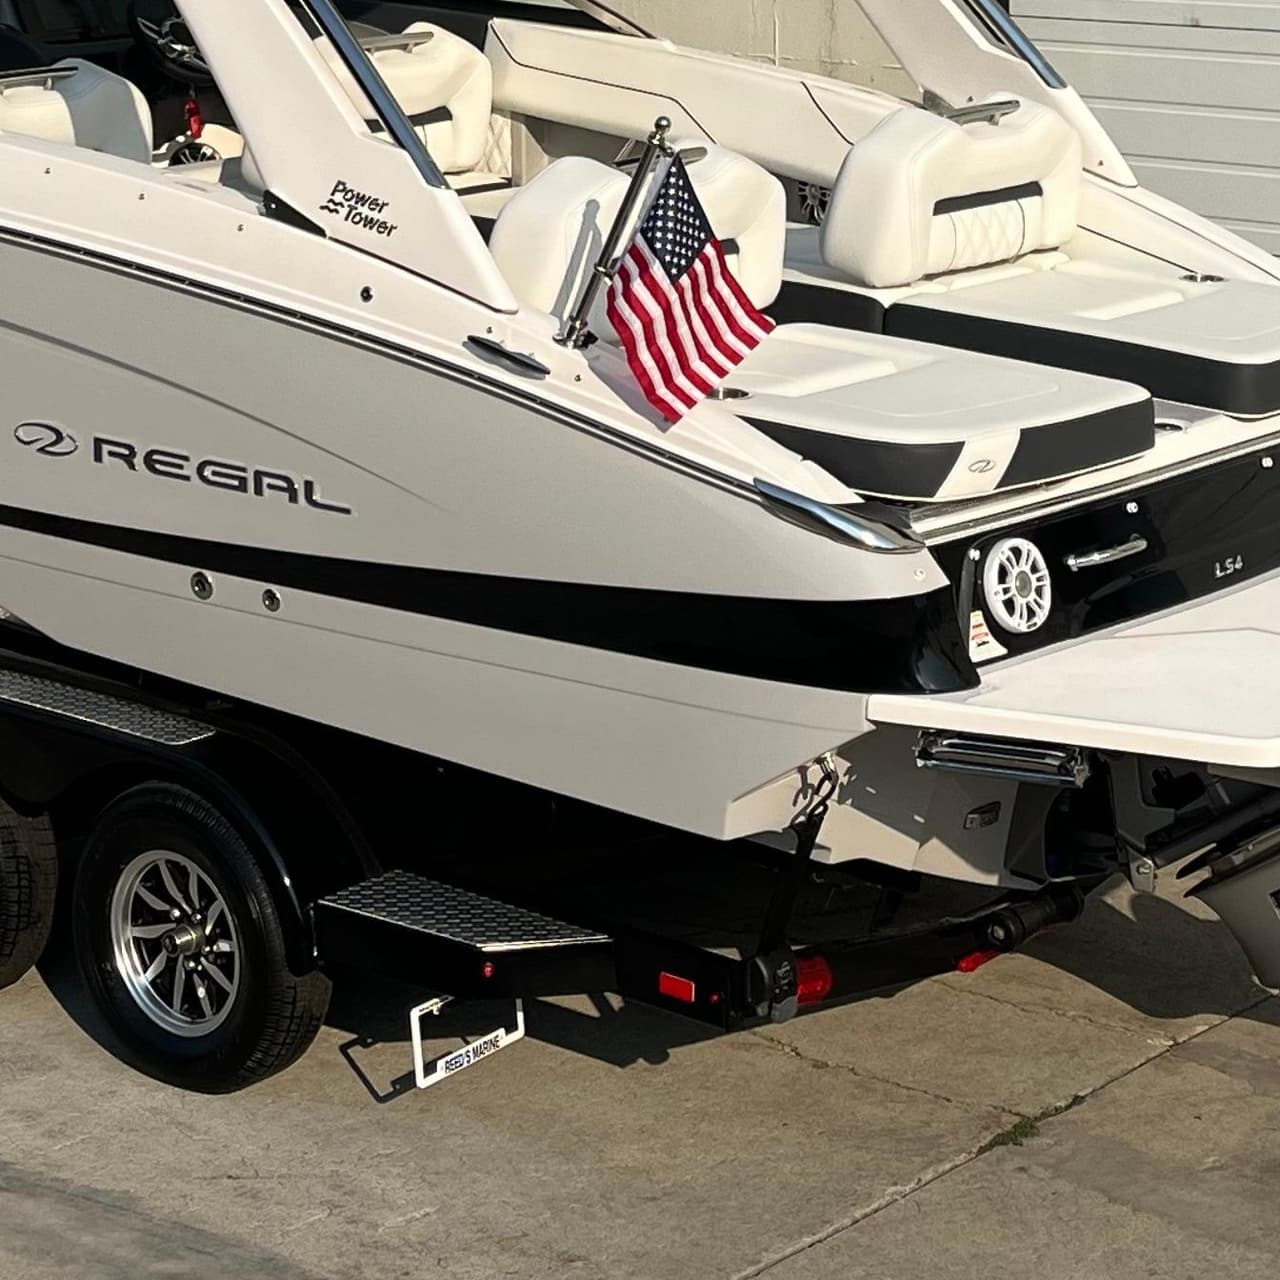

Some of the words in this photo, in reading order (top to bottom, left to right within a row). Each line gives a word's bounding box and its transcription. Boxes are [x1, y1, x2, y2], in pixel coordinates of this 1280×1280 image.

[330, 180, 389, 213] Power
[344, 204, 398, 237] Tower
[93, 436, 351, 515] REGAL
[1215, 555, 1243, 578] LS4
[472, 1034, 500, 1060] MARINE
